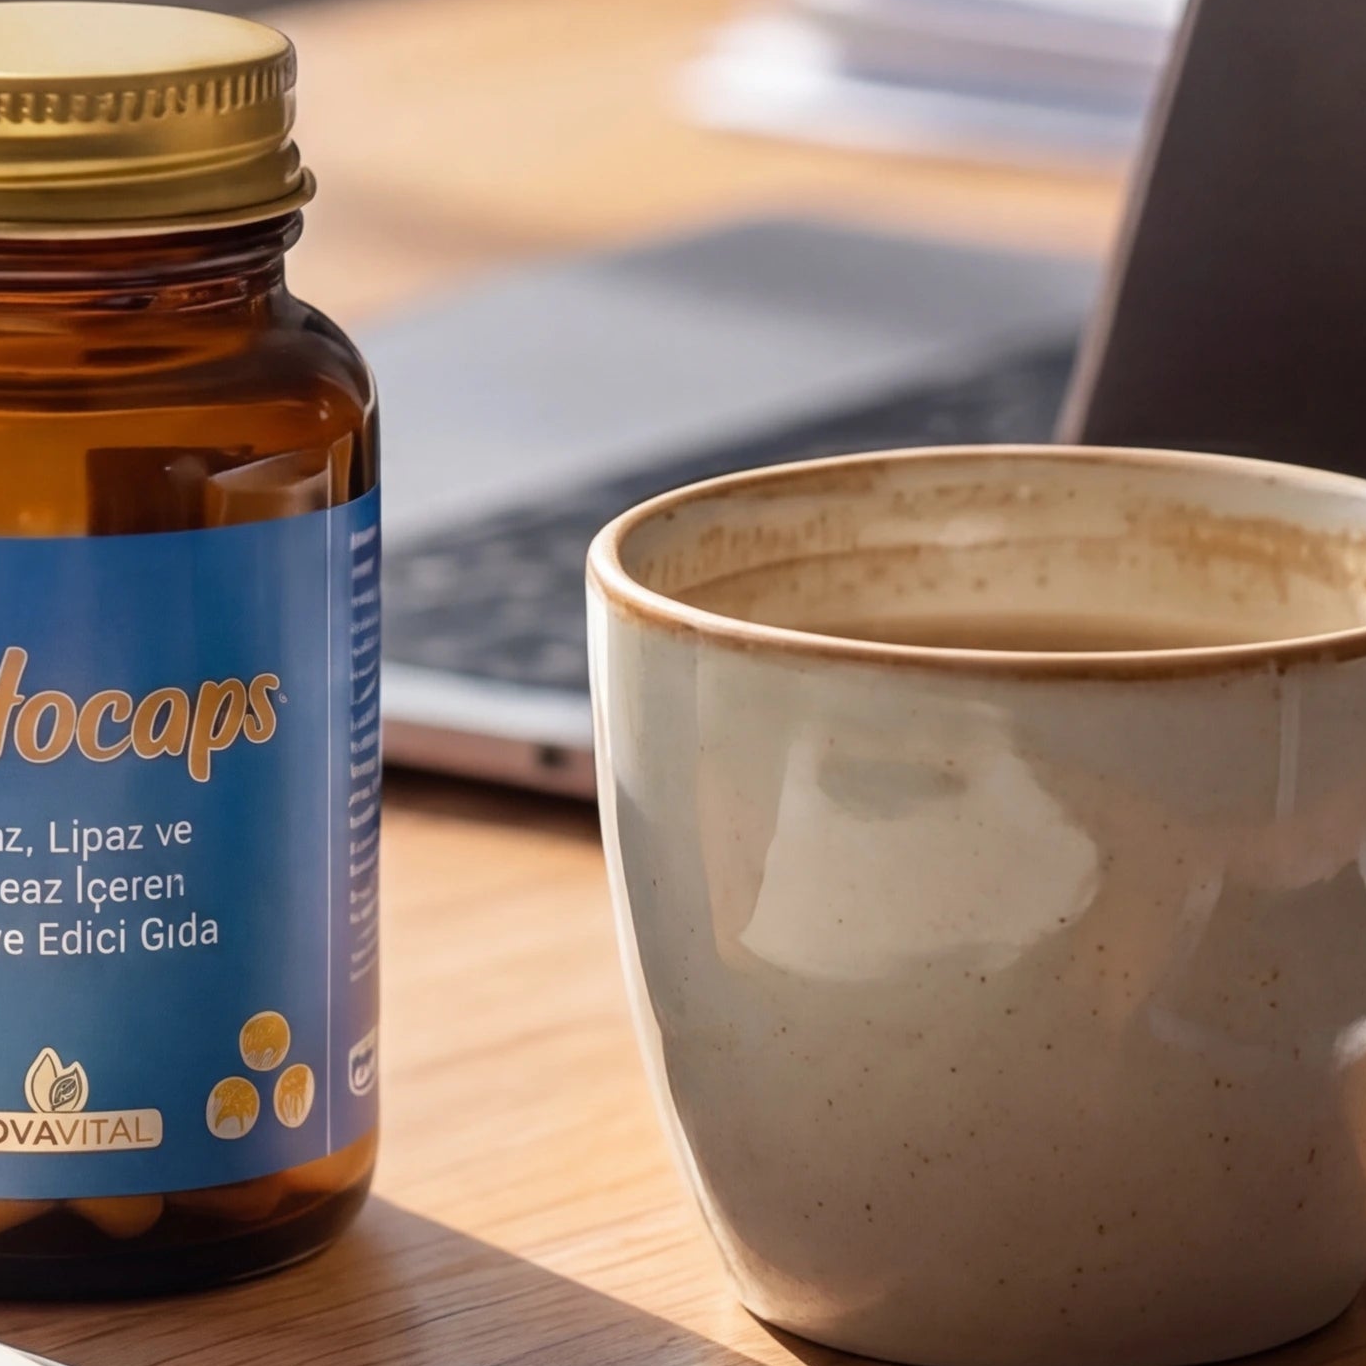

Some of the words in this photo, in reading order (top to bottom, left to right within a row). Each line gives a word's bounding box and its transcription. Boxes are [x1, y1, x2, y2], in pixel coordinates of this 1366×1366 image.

[49, 818, 144, 862] Lipaz
[155, 820, 193, 847] ve
[39, 919, 126, 956] Edici
[140, 911, 219, 951] Gıda
